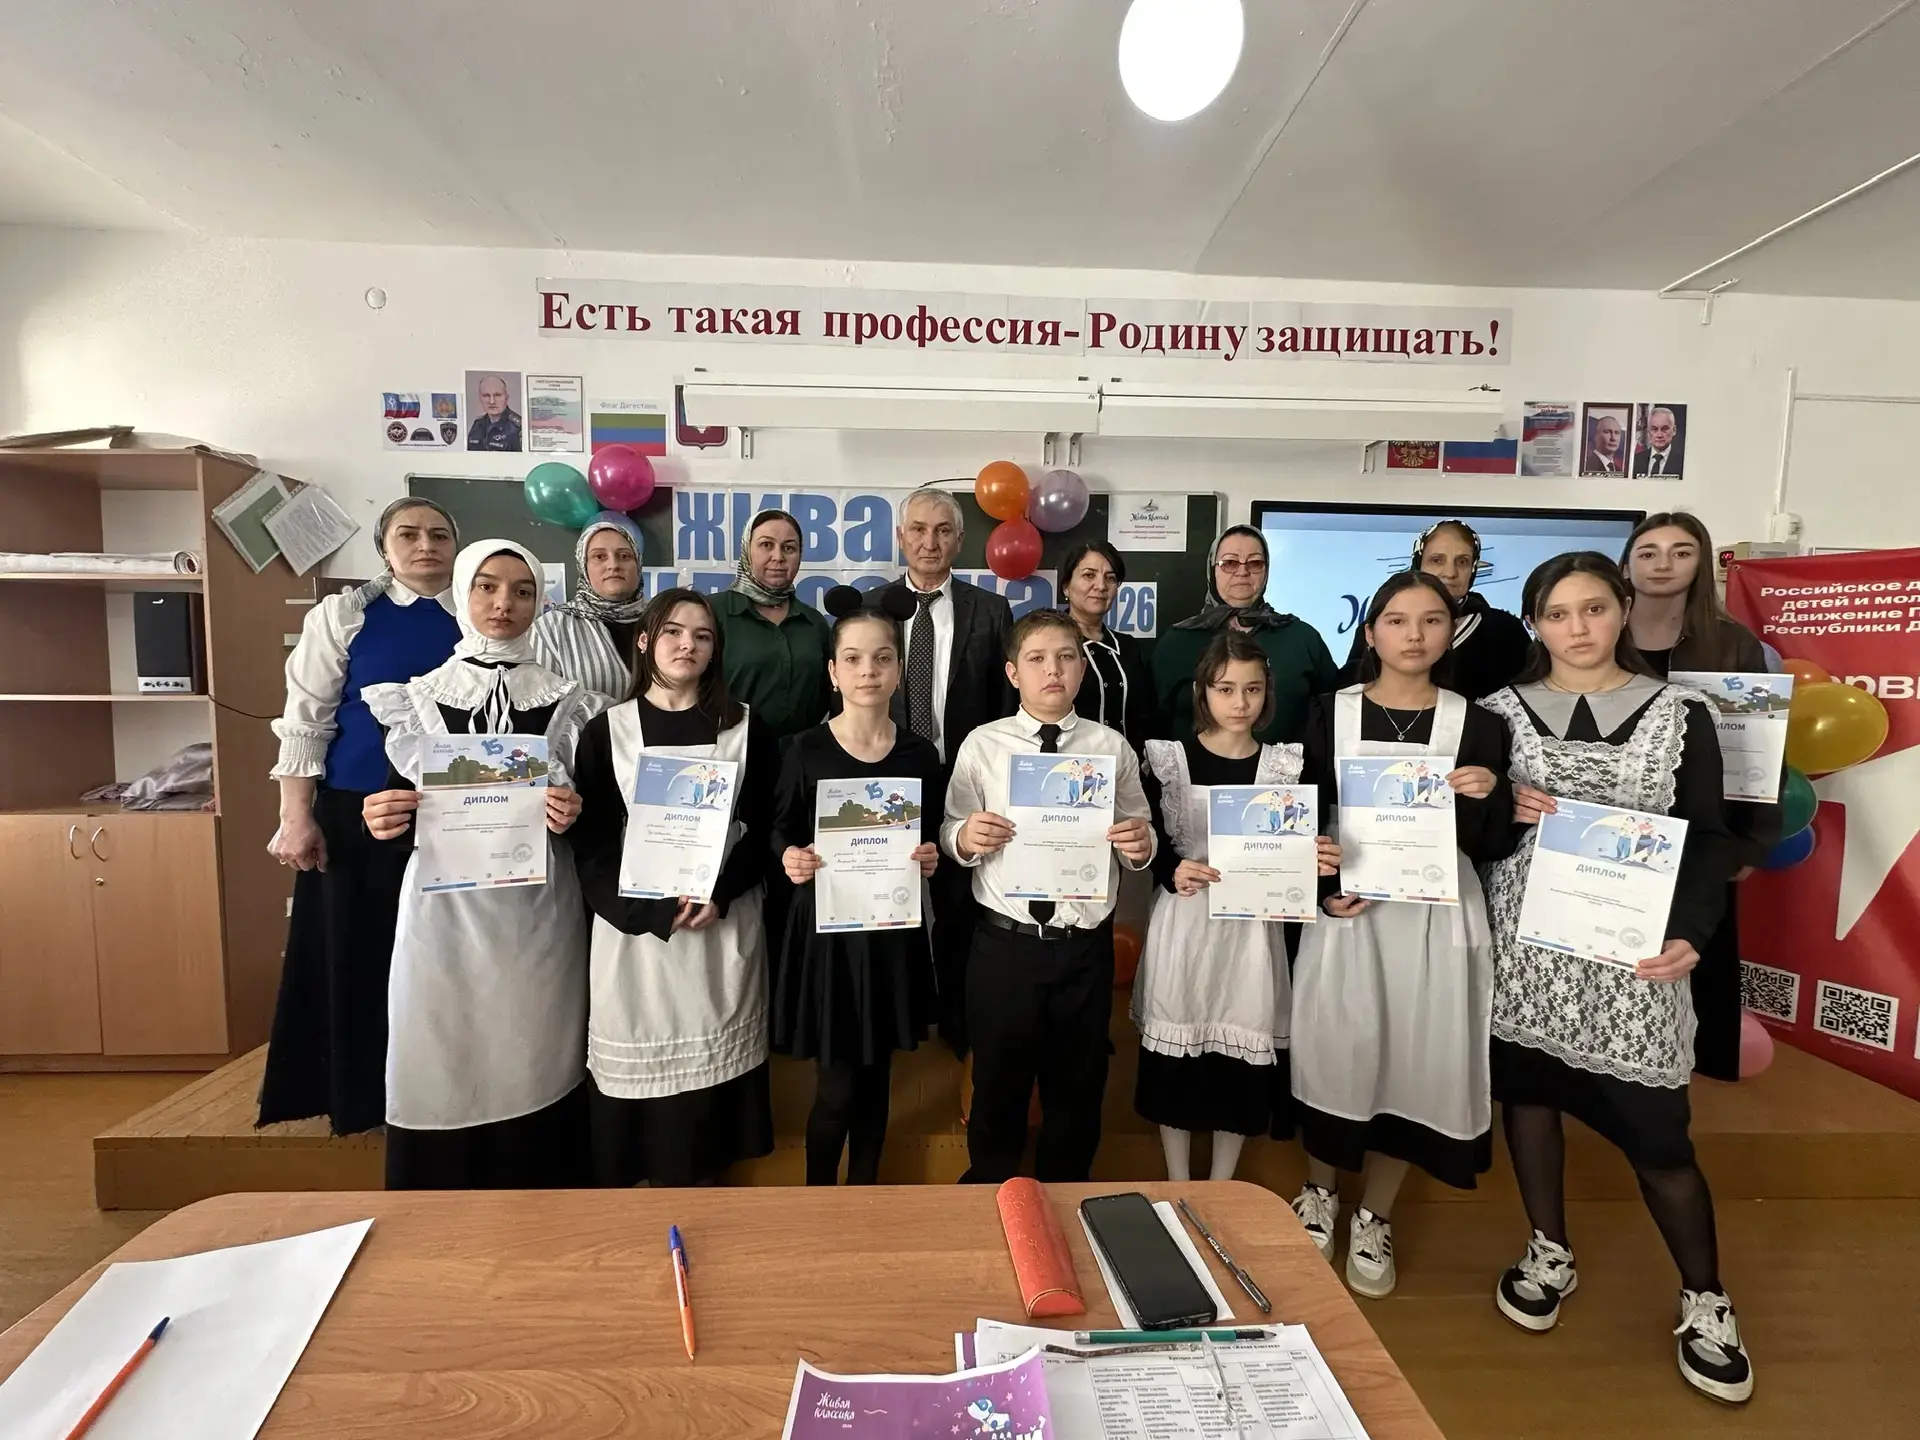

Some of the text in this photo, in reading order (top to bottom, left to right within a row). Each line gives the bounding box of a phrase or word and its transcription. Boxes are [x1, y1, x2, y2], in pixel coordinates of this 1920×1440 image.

[540, 292, 1500, 361] Есть такая профессия- Родину защищать!
[620, 402, 658, 410] Дагестана
[1760, 582, 1902, 597] Российское
[1781, 596, 1849, 611] детей
[1854, 596, 1869, 606] и
[1771, 609, 1903, 624] «Движение
[1763, 622, 1901, 636] Республики
[1722, 676, 1744, 691] 15
[1716, 722, 1746, 731] ПЛОМ
[481, 738, 504, 756] 15
[865, 781, 884, 800] 15
[463, 795, 509, 806] ДИПЛОМ
[664, 812, 701, 823] ДИПЛОМ
[1041, 814, 1080, 823] ДИПЛОМ
[1375, 814, 1416, 823] ДИПЛОМ
[850, 837, 888, 847] ДИПЛОМ
[1243, 842, 1282, 851] ДИПЛОМ
[1575, 863, 1627, 881] ДИПЛОМ
[816, 1391, 851, 1409] Живая
